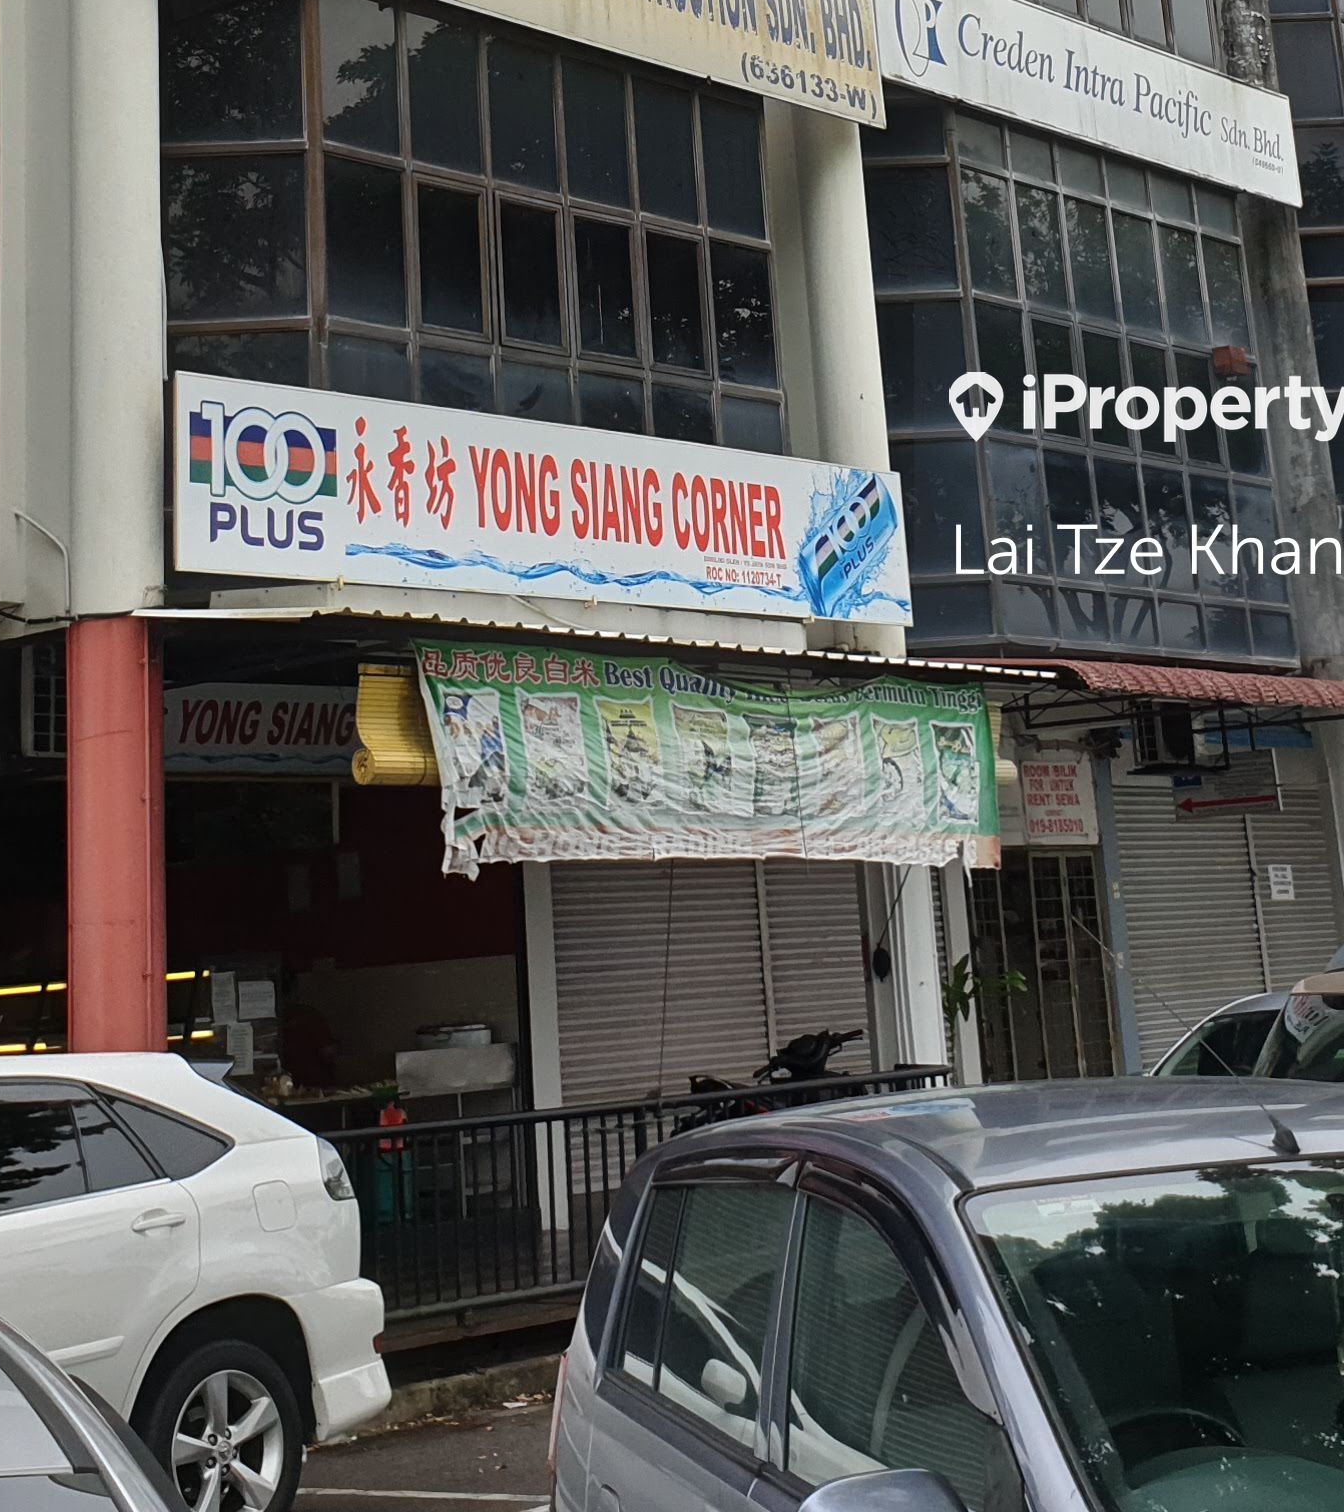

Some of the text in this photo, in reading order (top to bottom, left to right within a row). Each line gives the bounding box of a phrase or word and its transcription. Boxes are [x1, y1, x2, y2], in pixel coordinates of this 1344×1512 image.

[957, 13, 1285, 161] Creden Intra Pacific Sdn. Bhd.
[200, 400, 326, 506] 100
[346, 417, 457, 531] 永香坊
[209, 501, 325, 552] PLUS
[468, 444, 787, 561] YONG SIANG CORNER
[705, 566, 723, 581] ROC
[725, 567, 740, 583] NO:
[842, 537, 875, 580] PLUS
[420, 646, 601, 687] 品质优良白米
[603, 659, 655, 689] Best
[930, 685, 983, 715] Tinggi
[178, 698, 356, 747] YONG SIANG
[1023, 764, 1078, 778] ROOM BILIK
[1027, 793, 1080, 806] RENT SEWA
